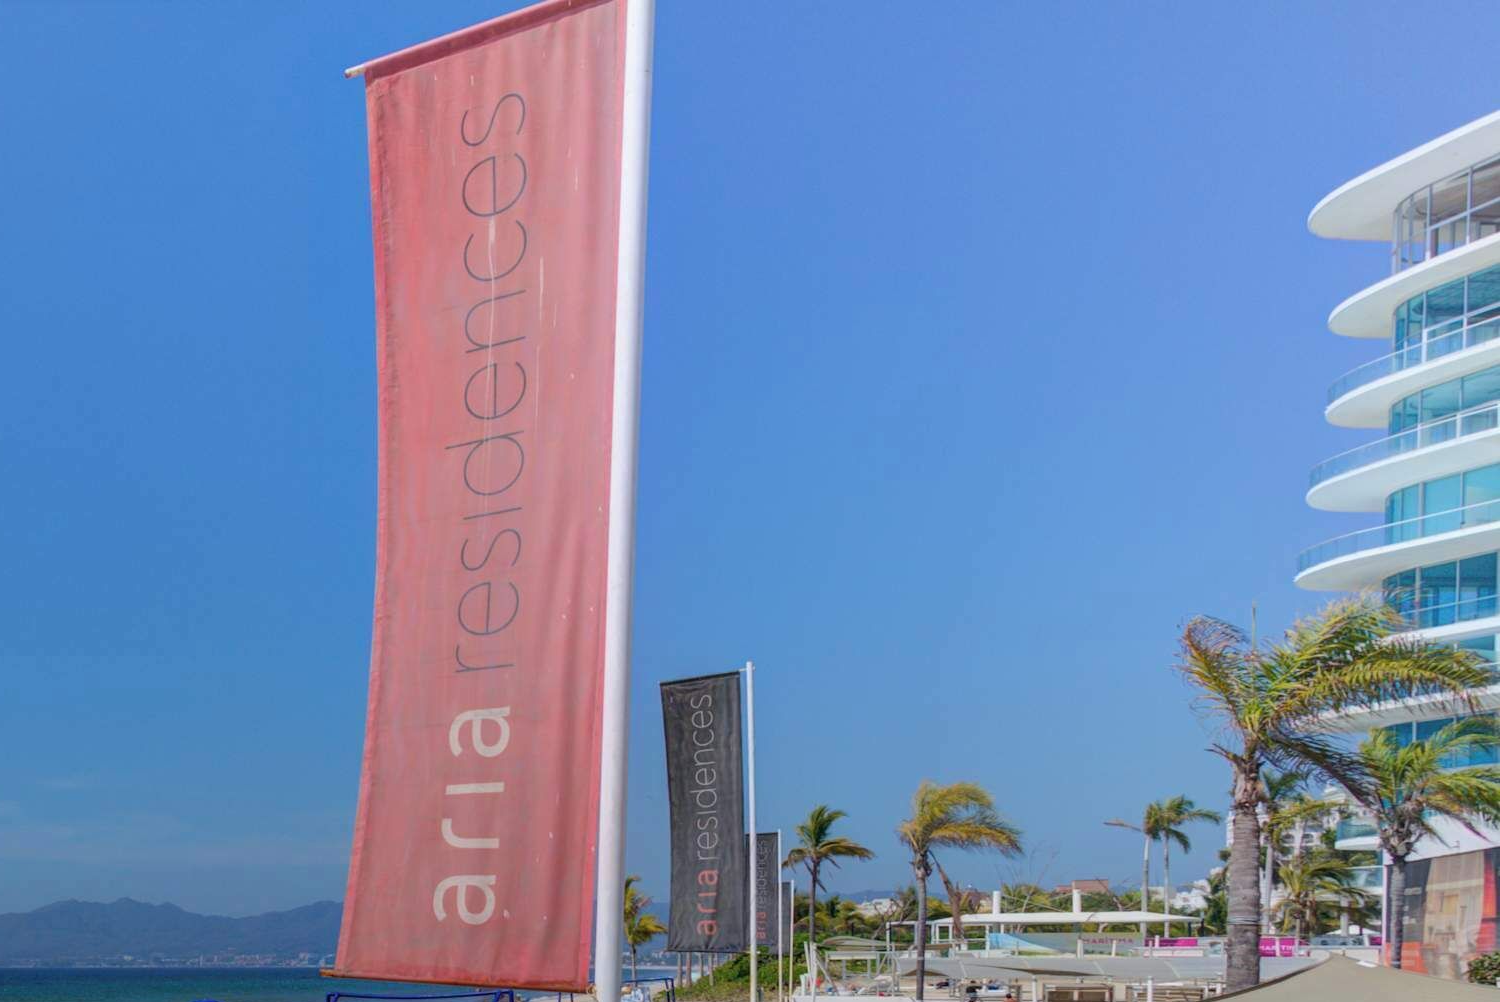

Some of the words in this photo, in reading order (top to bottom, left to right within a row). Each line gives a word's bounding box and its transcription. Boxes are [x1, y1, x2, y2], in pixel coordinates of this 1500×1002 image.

[444, 91, 527, 675] residences
[432, 704, 510, 926] aria
[690, 694, 719, 860] residences
[696, 869, 719, 936] aria
